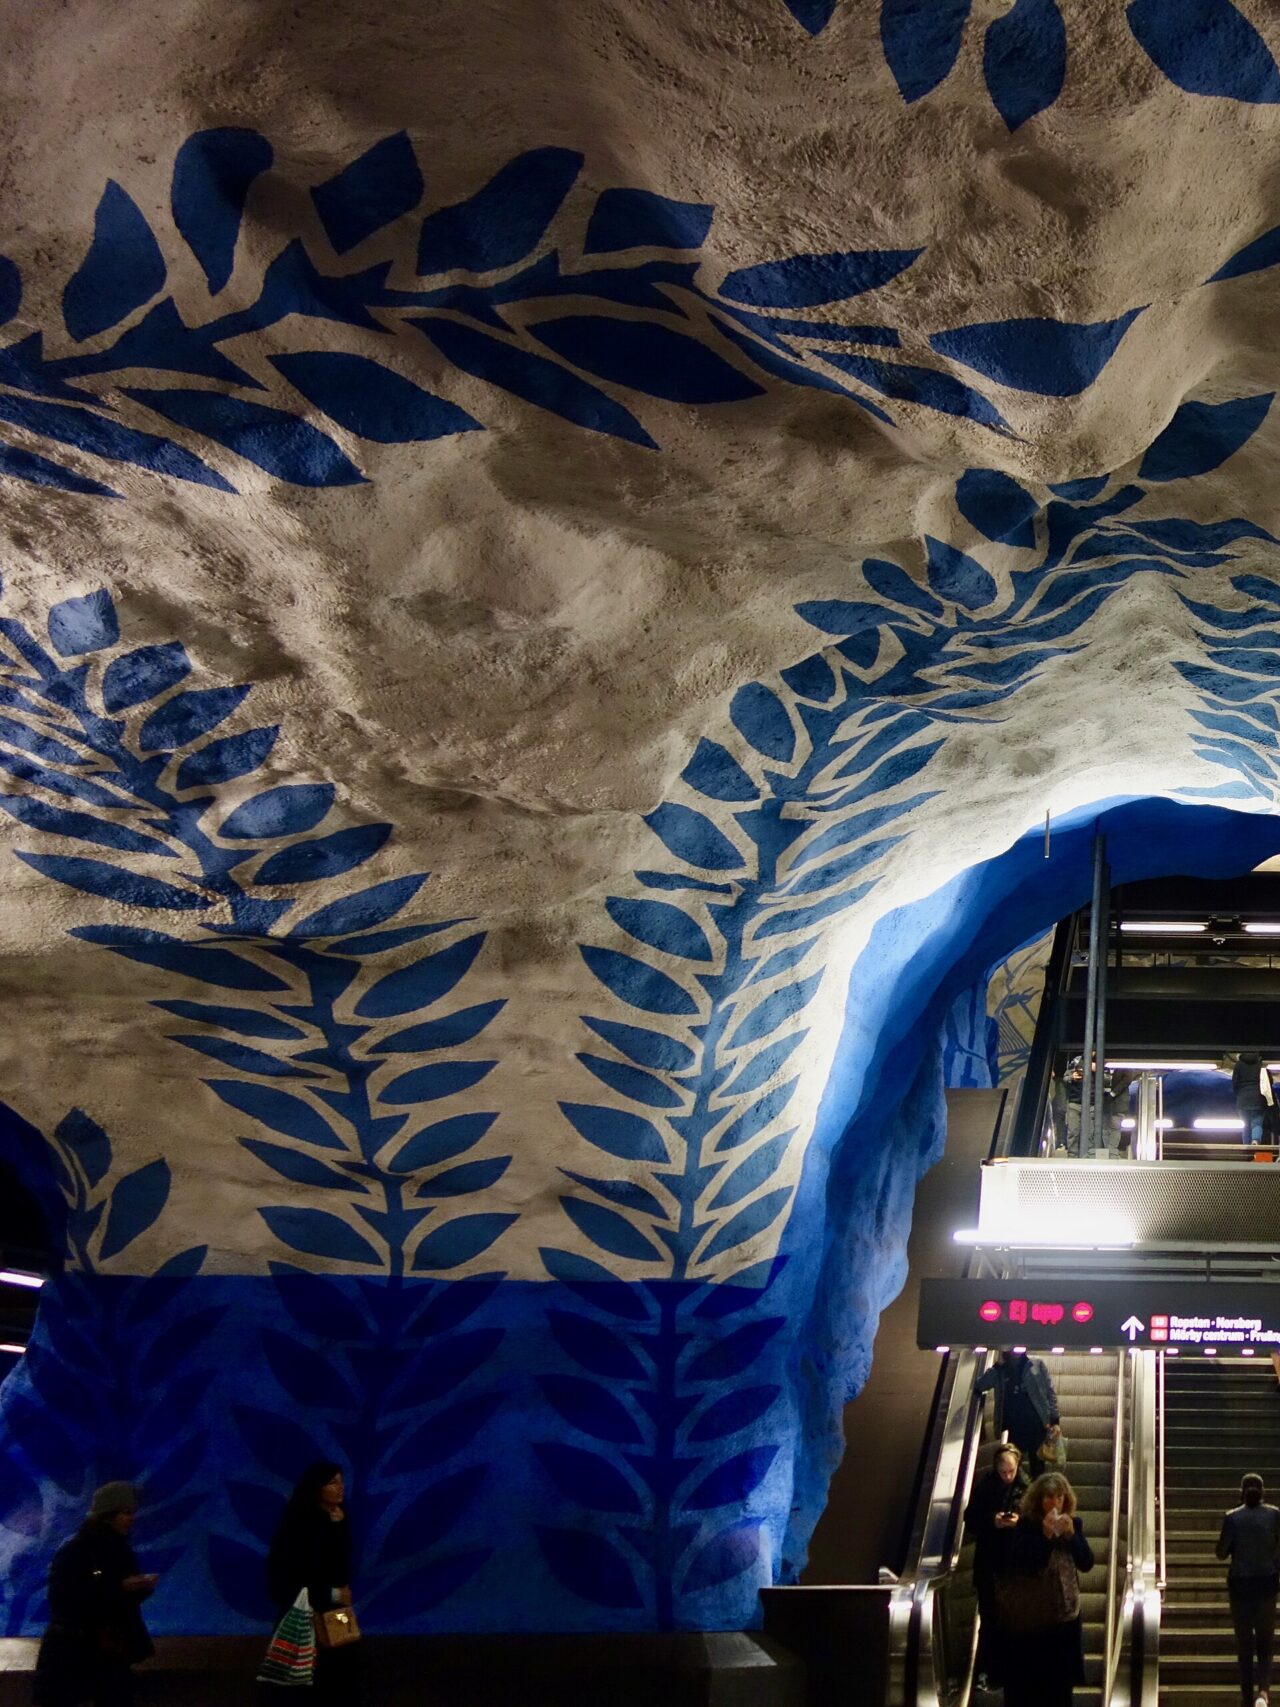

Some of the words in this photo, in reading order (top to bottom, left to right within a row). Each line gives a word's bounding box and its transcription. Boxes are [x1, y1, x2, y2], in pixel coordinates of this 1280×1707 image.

[1170, 1316, 1210, 1329] Ropsten
[1216, 1317, 1262, 1331] Norsborg
[1170, 1330, 1202, 1343] Mörby
[1203, 1331, 1244, 1341] centrum
